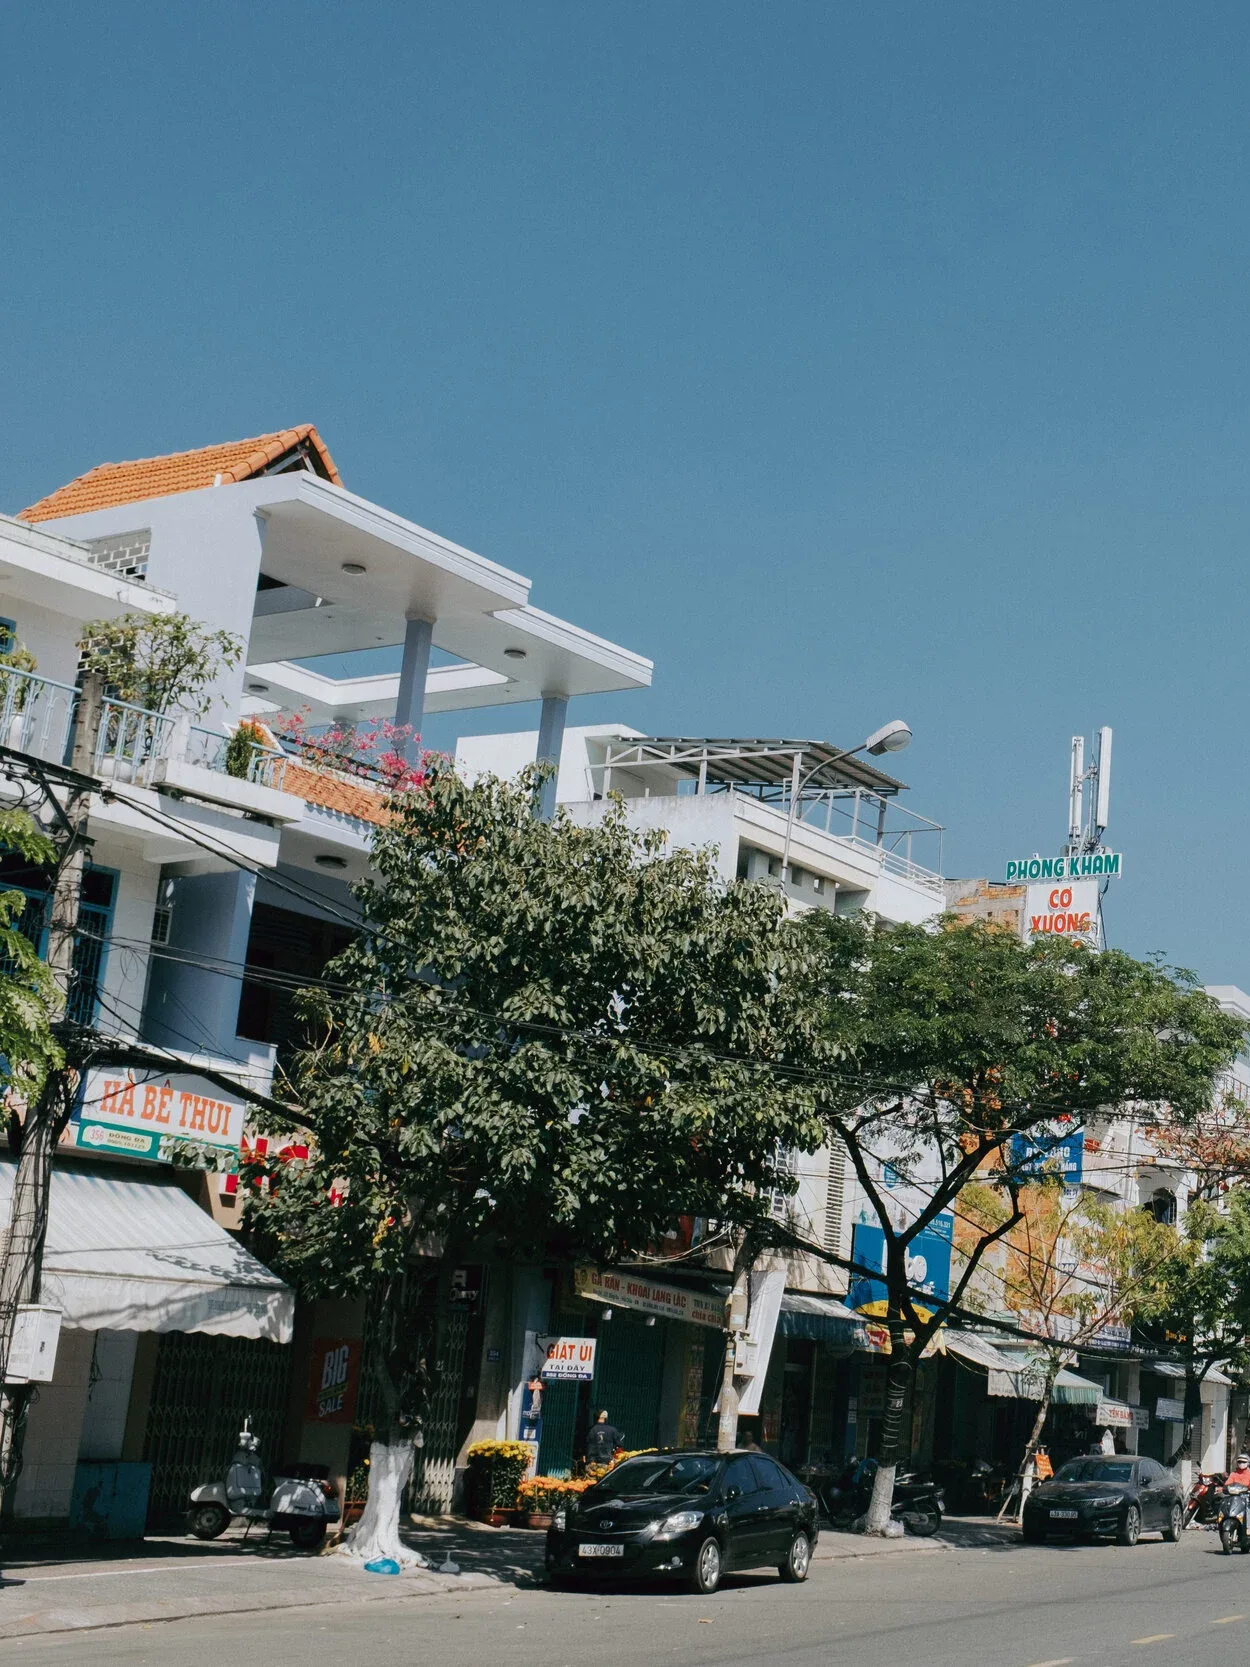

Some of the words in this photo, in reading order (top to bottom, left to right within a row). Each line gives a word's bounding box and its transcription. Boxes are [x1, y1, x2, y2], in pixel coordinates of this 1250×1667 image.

[1006, 853, 1065, 880] PHÒNG
[1049, 886, 1073, 909] CƠ
[1031, 911, 1091, 934] XƯƠNG
[141, 1079, 173, 1123] BÊ
[179, 1091, 232, 1136] THUI
[547, 1341, 575, 1363] GIẶT
[321, 1344, 349, 1389] BIG
[318, 1395, 343, 1417] SALE
